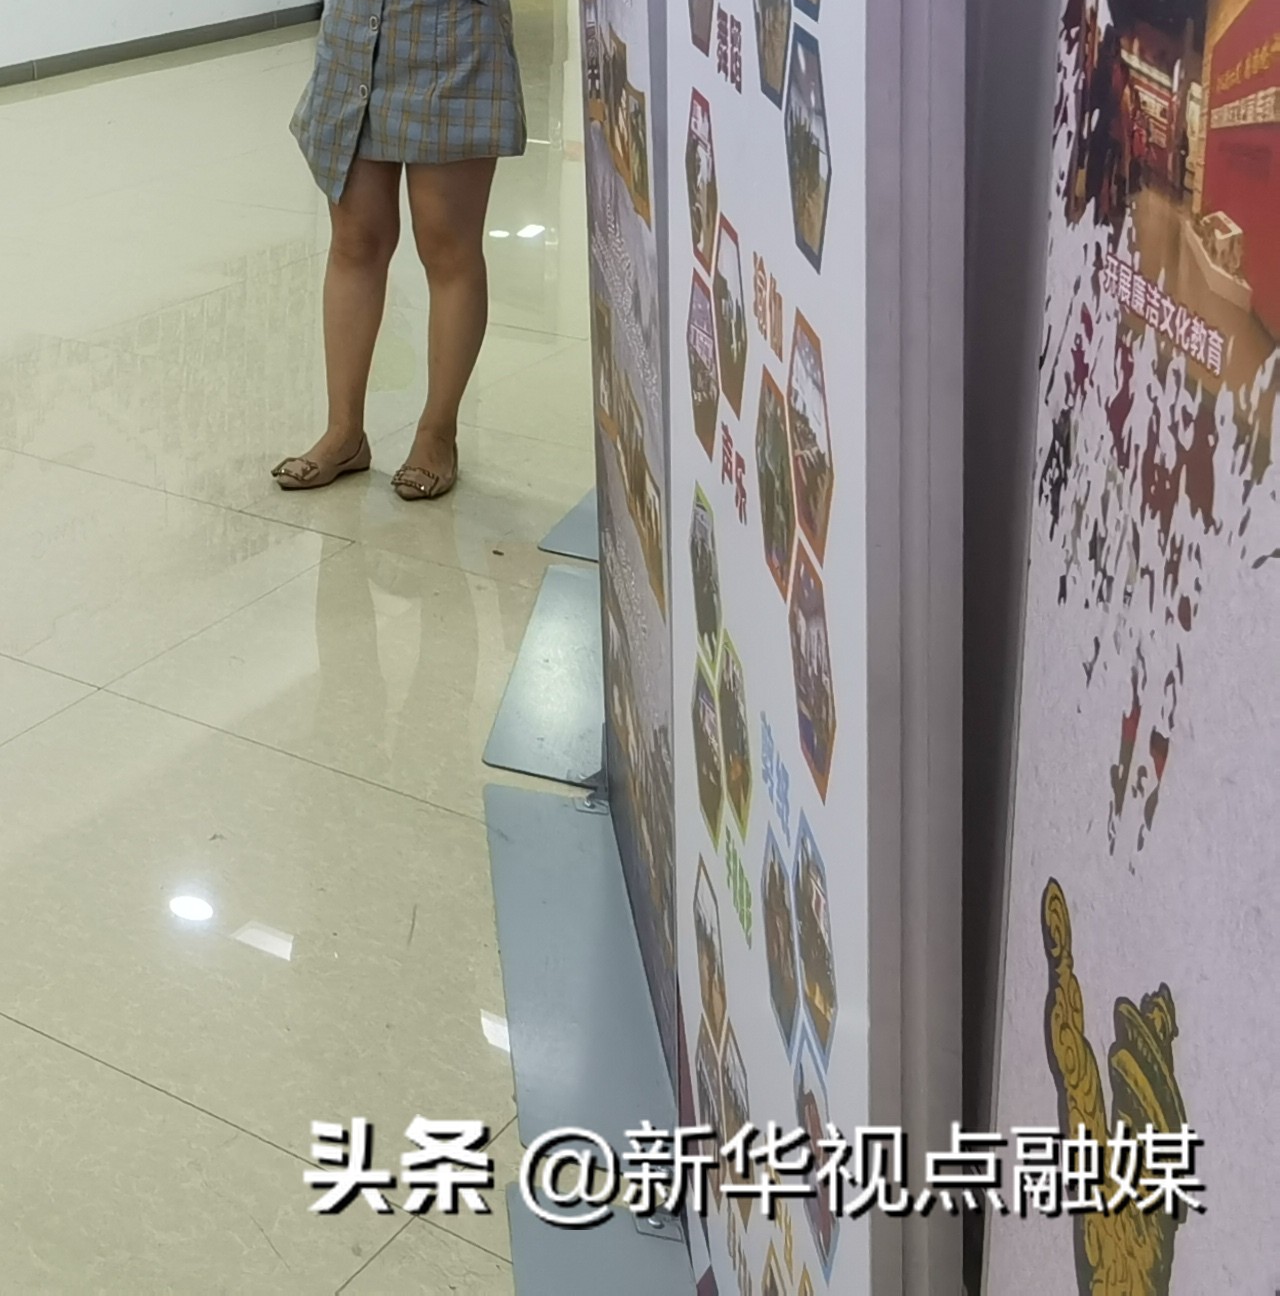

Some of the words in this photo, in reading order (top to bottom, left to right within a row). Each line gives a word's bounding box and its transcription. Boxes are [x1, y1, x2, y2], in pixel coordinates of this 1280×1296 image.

[1104, 254, 1224, 376] 开展廉洁文化教育
